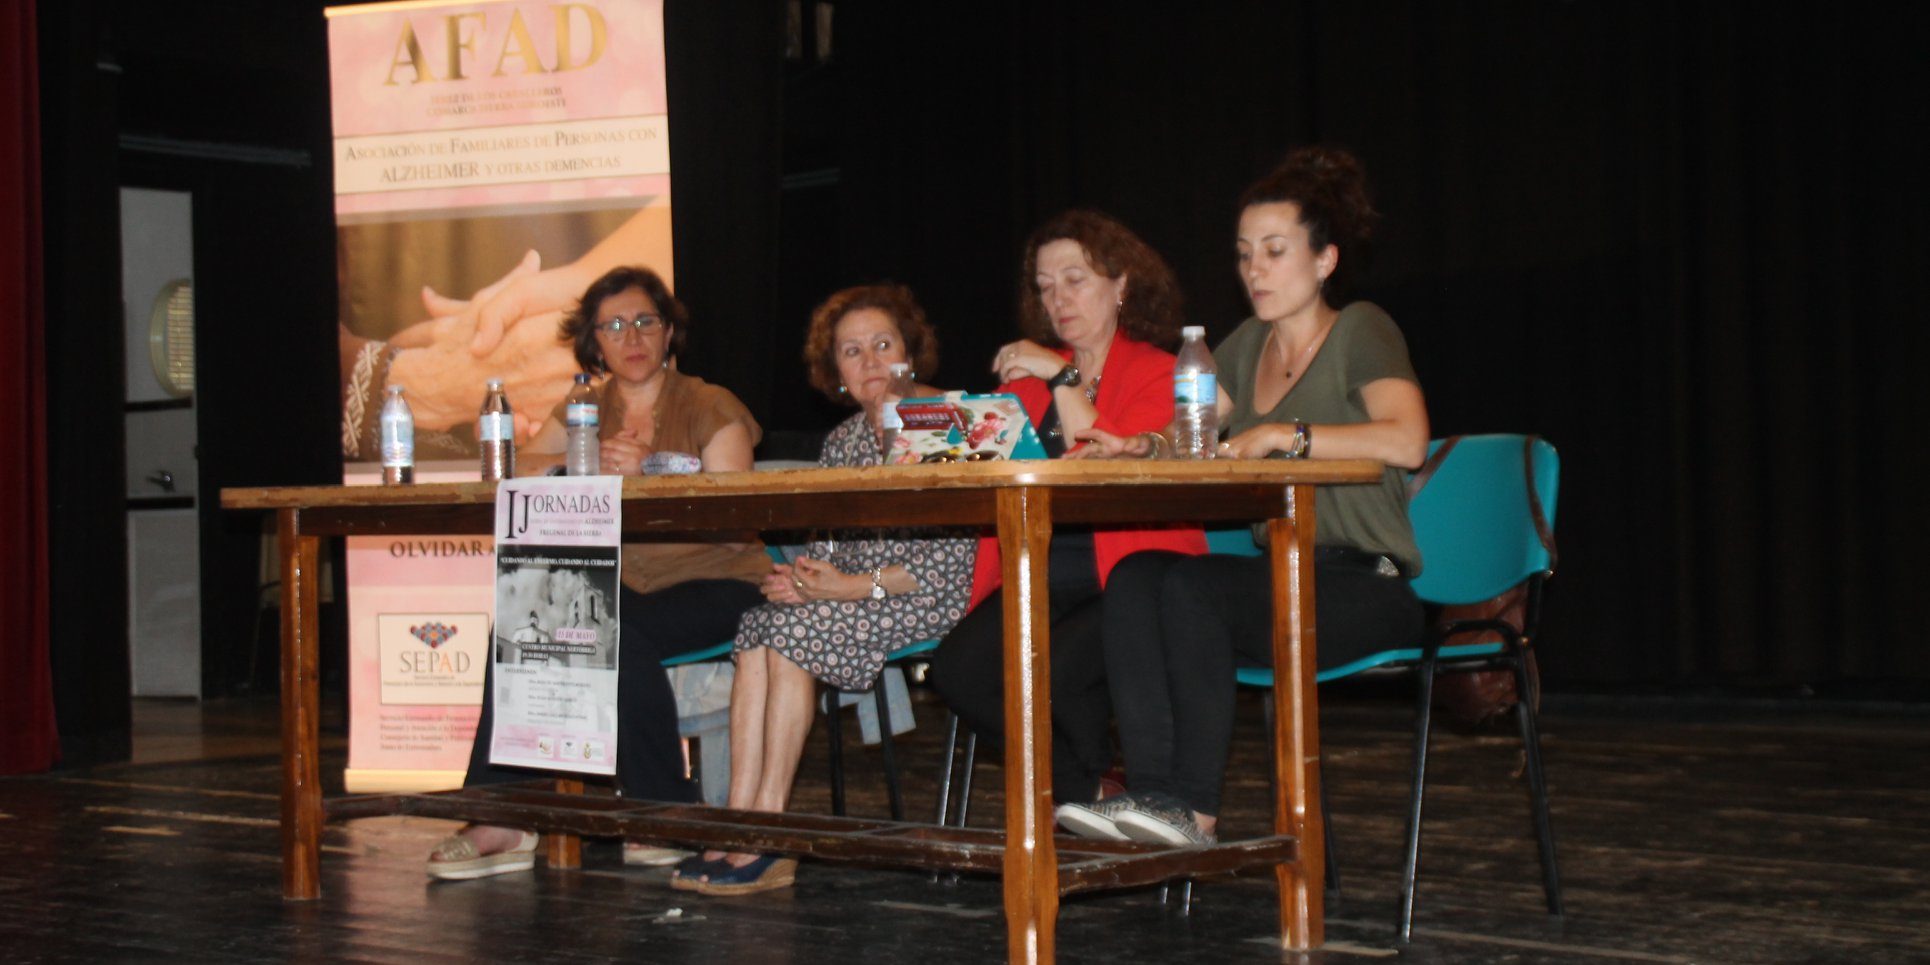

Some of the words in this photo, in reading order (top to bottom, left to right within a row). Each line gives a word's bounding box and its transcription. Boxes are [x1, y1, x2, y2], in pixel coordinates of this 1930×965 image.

[382, 2, 608, 87] AFAD
[534, 134, 552, 148] DE
[554, 129, 626, 148] PERSONAS
[628, 127, 657, 142] CON
[380, 162, 480, 183] ALZHEIMER
[497, 160, 541, 175] OTRAS
[544, 155, 622, 173] DEMENCIAS
[518, 494, 611, 534] JORNADAS
[390, 540, 484, 558] OLVIDAR
[400, 651, 471, 673] SEPAD
